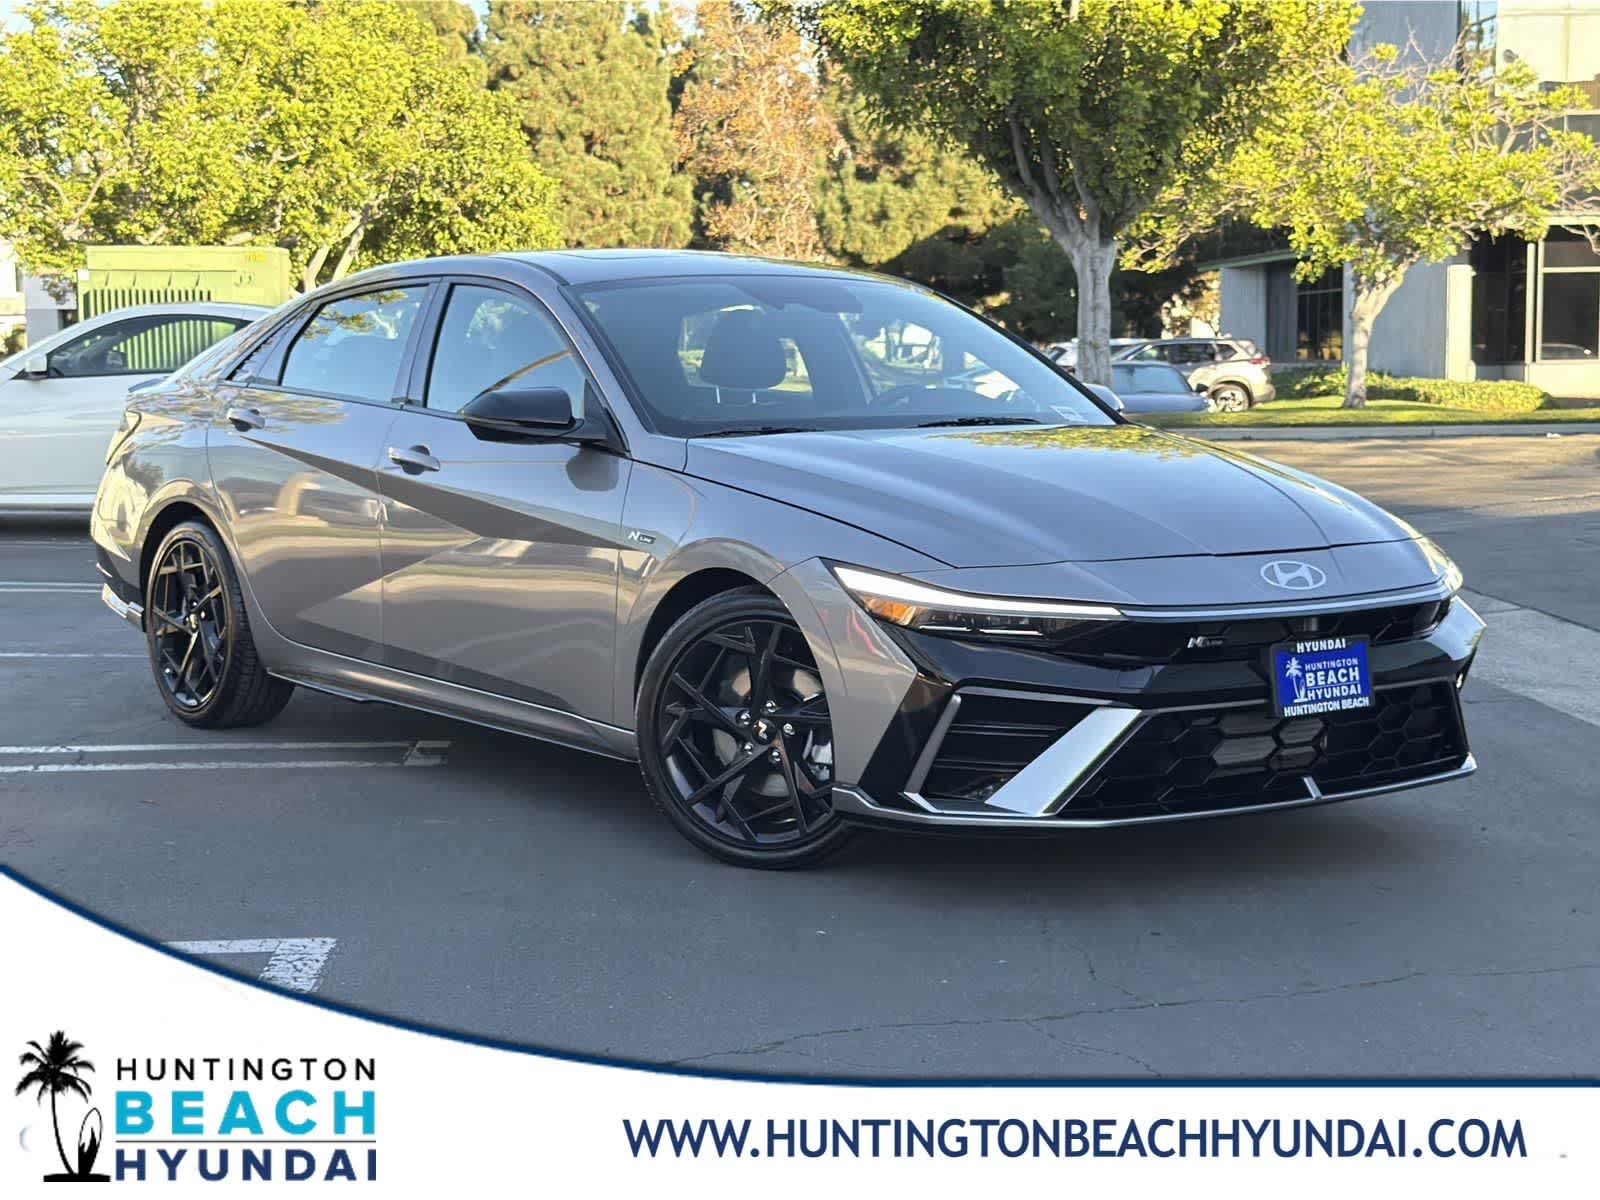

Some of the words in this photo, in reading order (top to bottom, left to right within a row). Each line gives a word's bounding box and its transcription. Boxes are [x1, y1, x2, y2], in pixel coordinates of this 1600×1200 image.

[1296, 638, 1346, 653] HYUNDAI
[1304, 657, 1359, 671] HUNTINGTON
[1305, 666, 1359, 687] BEACH
[1307, 684, 1361, 701] HYUNDAI
[1284, 702, 1341, 717] HUNTINGTON
[1341, 697, 1369, 709] BEACH
